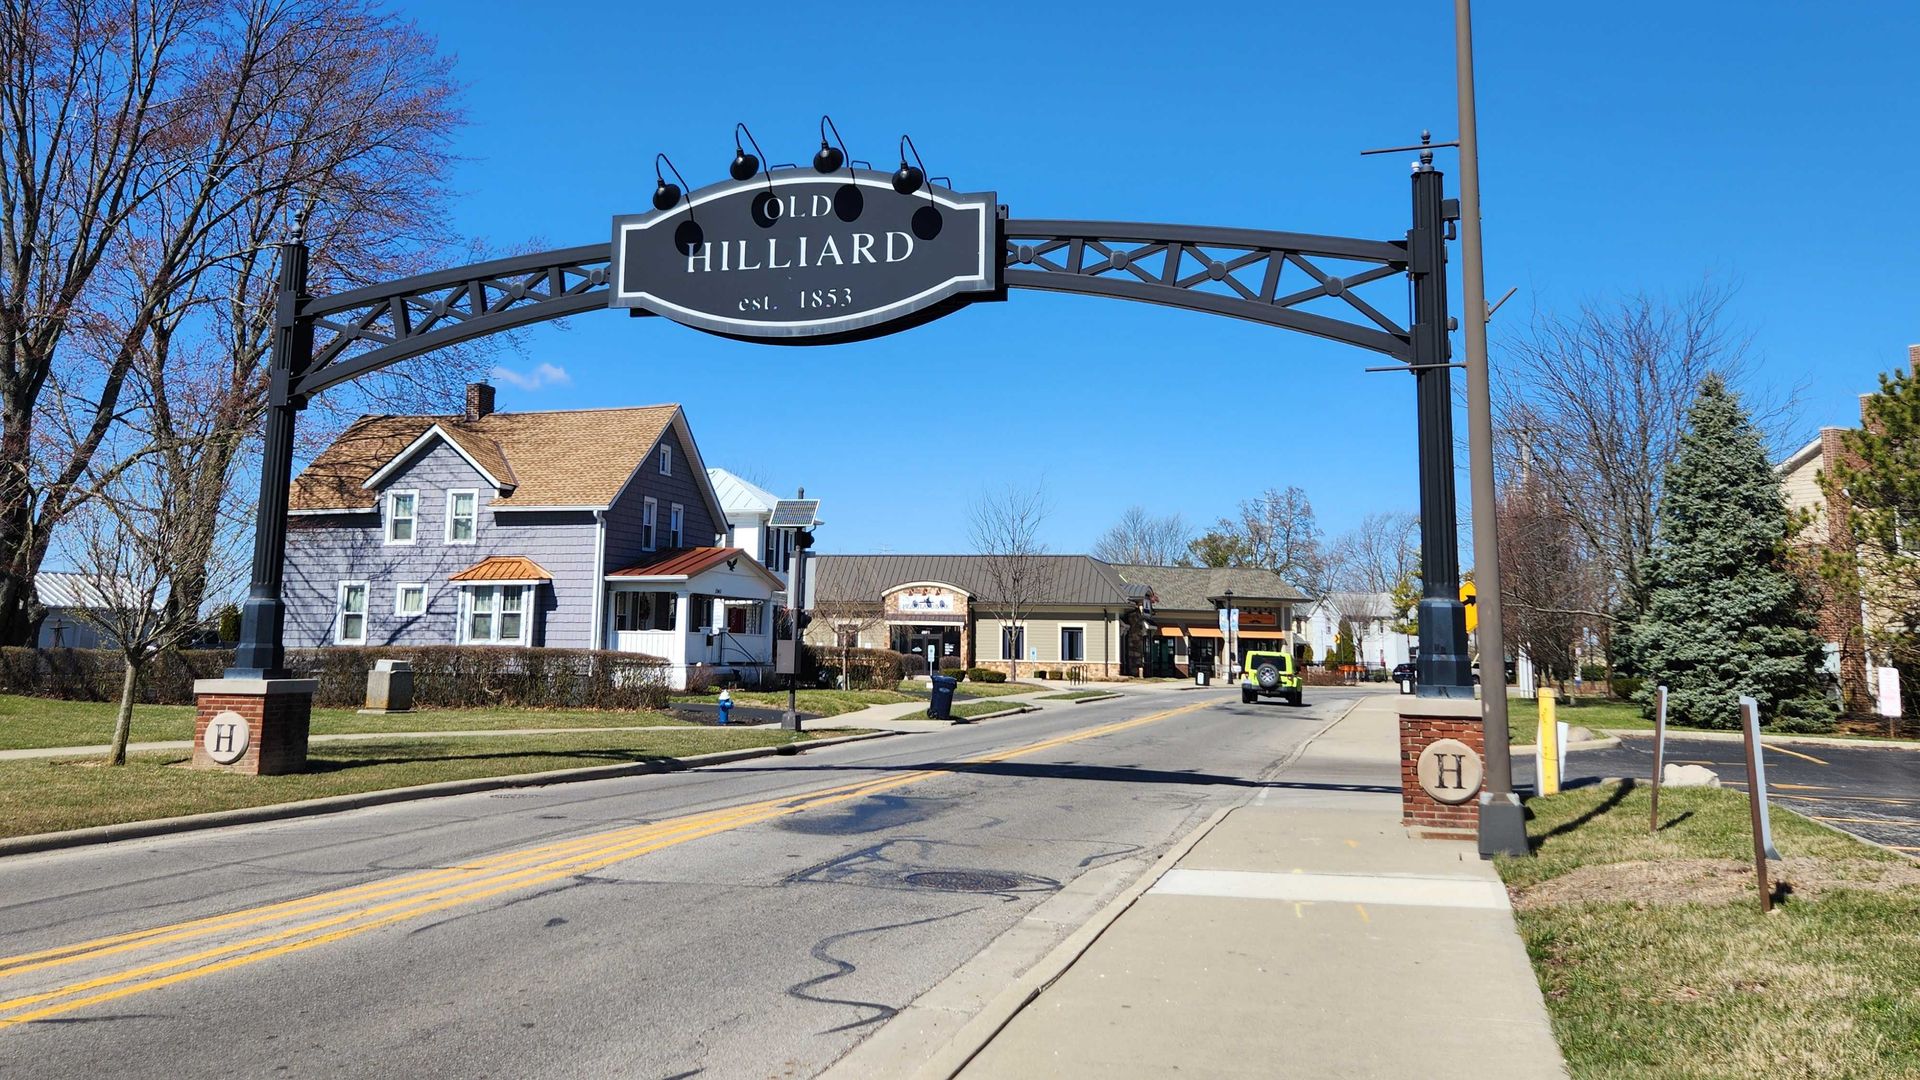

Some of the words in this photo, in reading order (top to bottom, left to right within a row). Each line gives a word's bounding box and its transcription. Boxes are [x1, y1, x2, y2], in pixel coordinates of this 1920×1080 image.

[763, 195, 832, 220] OLD
[687, 231, 915, 273] HILLIARD
[738, 295, 778, 311] est.
[800, 288, 852, 308] 1853
[213, 723, 237, 752] H
[1433, 753, 1467, 789] H
